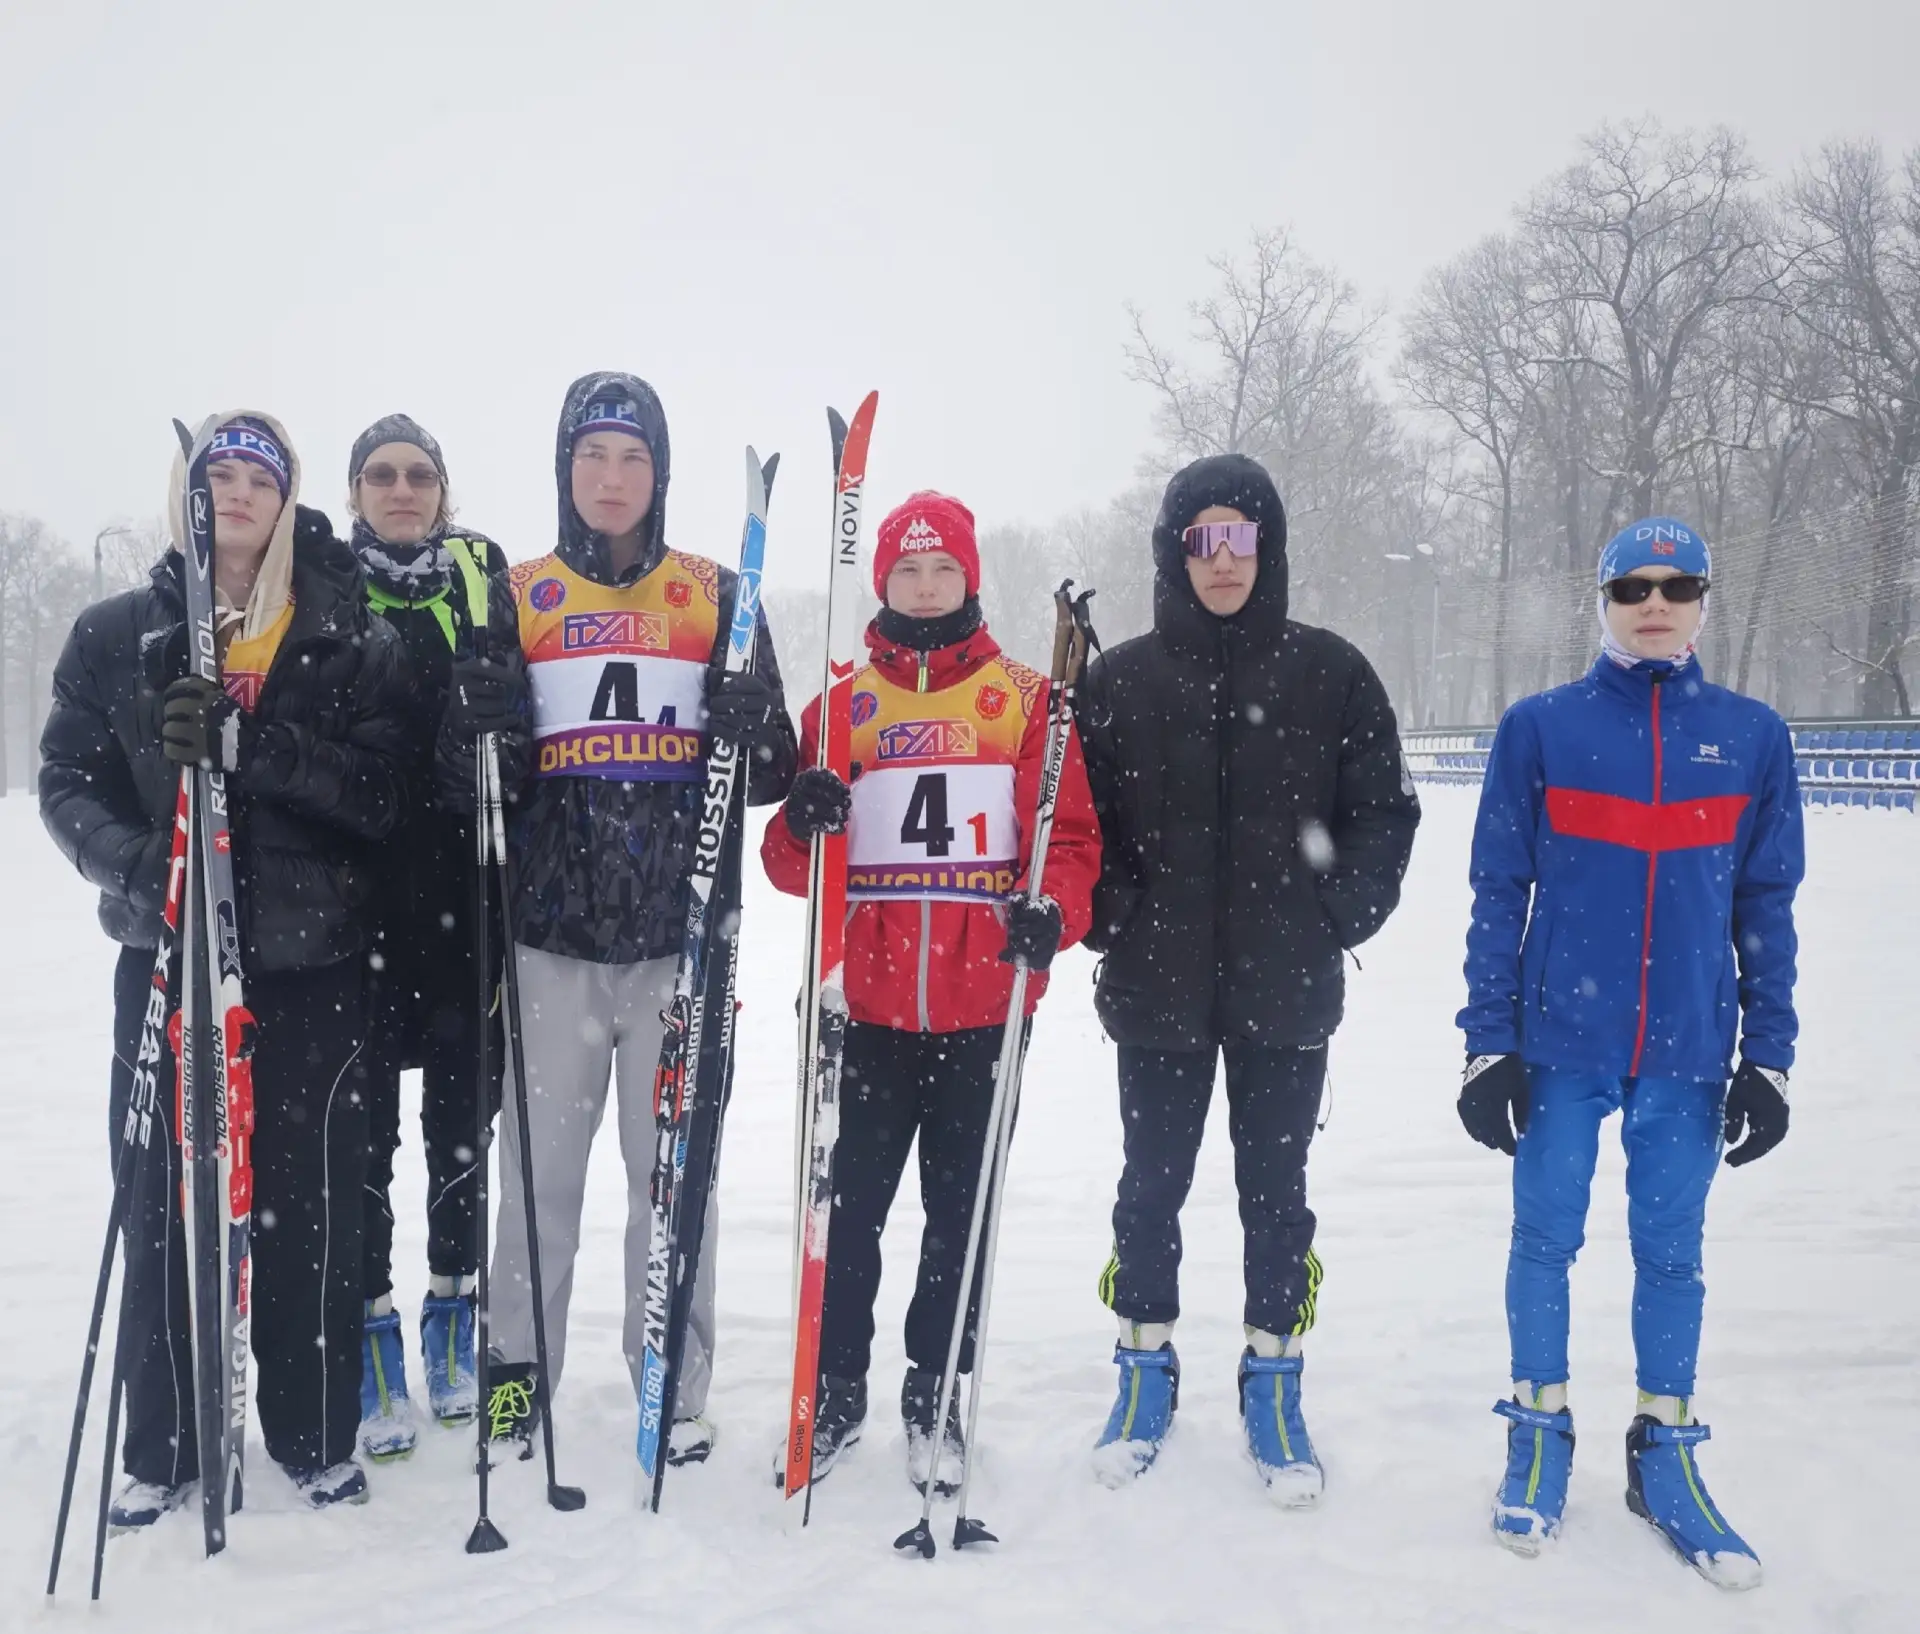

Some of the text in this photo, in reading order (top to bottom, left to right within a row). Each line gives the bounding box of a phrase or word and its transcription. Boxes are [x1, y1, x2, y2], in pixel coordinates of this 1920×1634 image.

[840, 472, 863, 565] INOVIK
[900, 536, 943, 552] Kappa
[1636, 525, 1690, 543] DNB
[589, 661, 646, 722] 4
[539, 733, 700, 772] ОКСШОР
[1046, 733, 1067, 805] NORDWAY
[694, 736, 735, 878] ROSSIG
[901, 773, 987, 857] 4 1
[183, 1024, 194, 1142] ROSSIGNOL
[212, 1024, 227, 1139] ROSSIGNOL
[681, 994, 703, 1112] ROSSIGNOL
[643, 1243, 670, 1354] ZYMAX
[794, 1425, 805, 1463] COMBI
